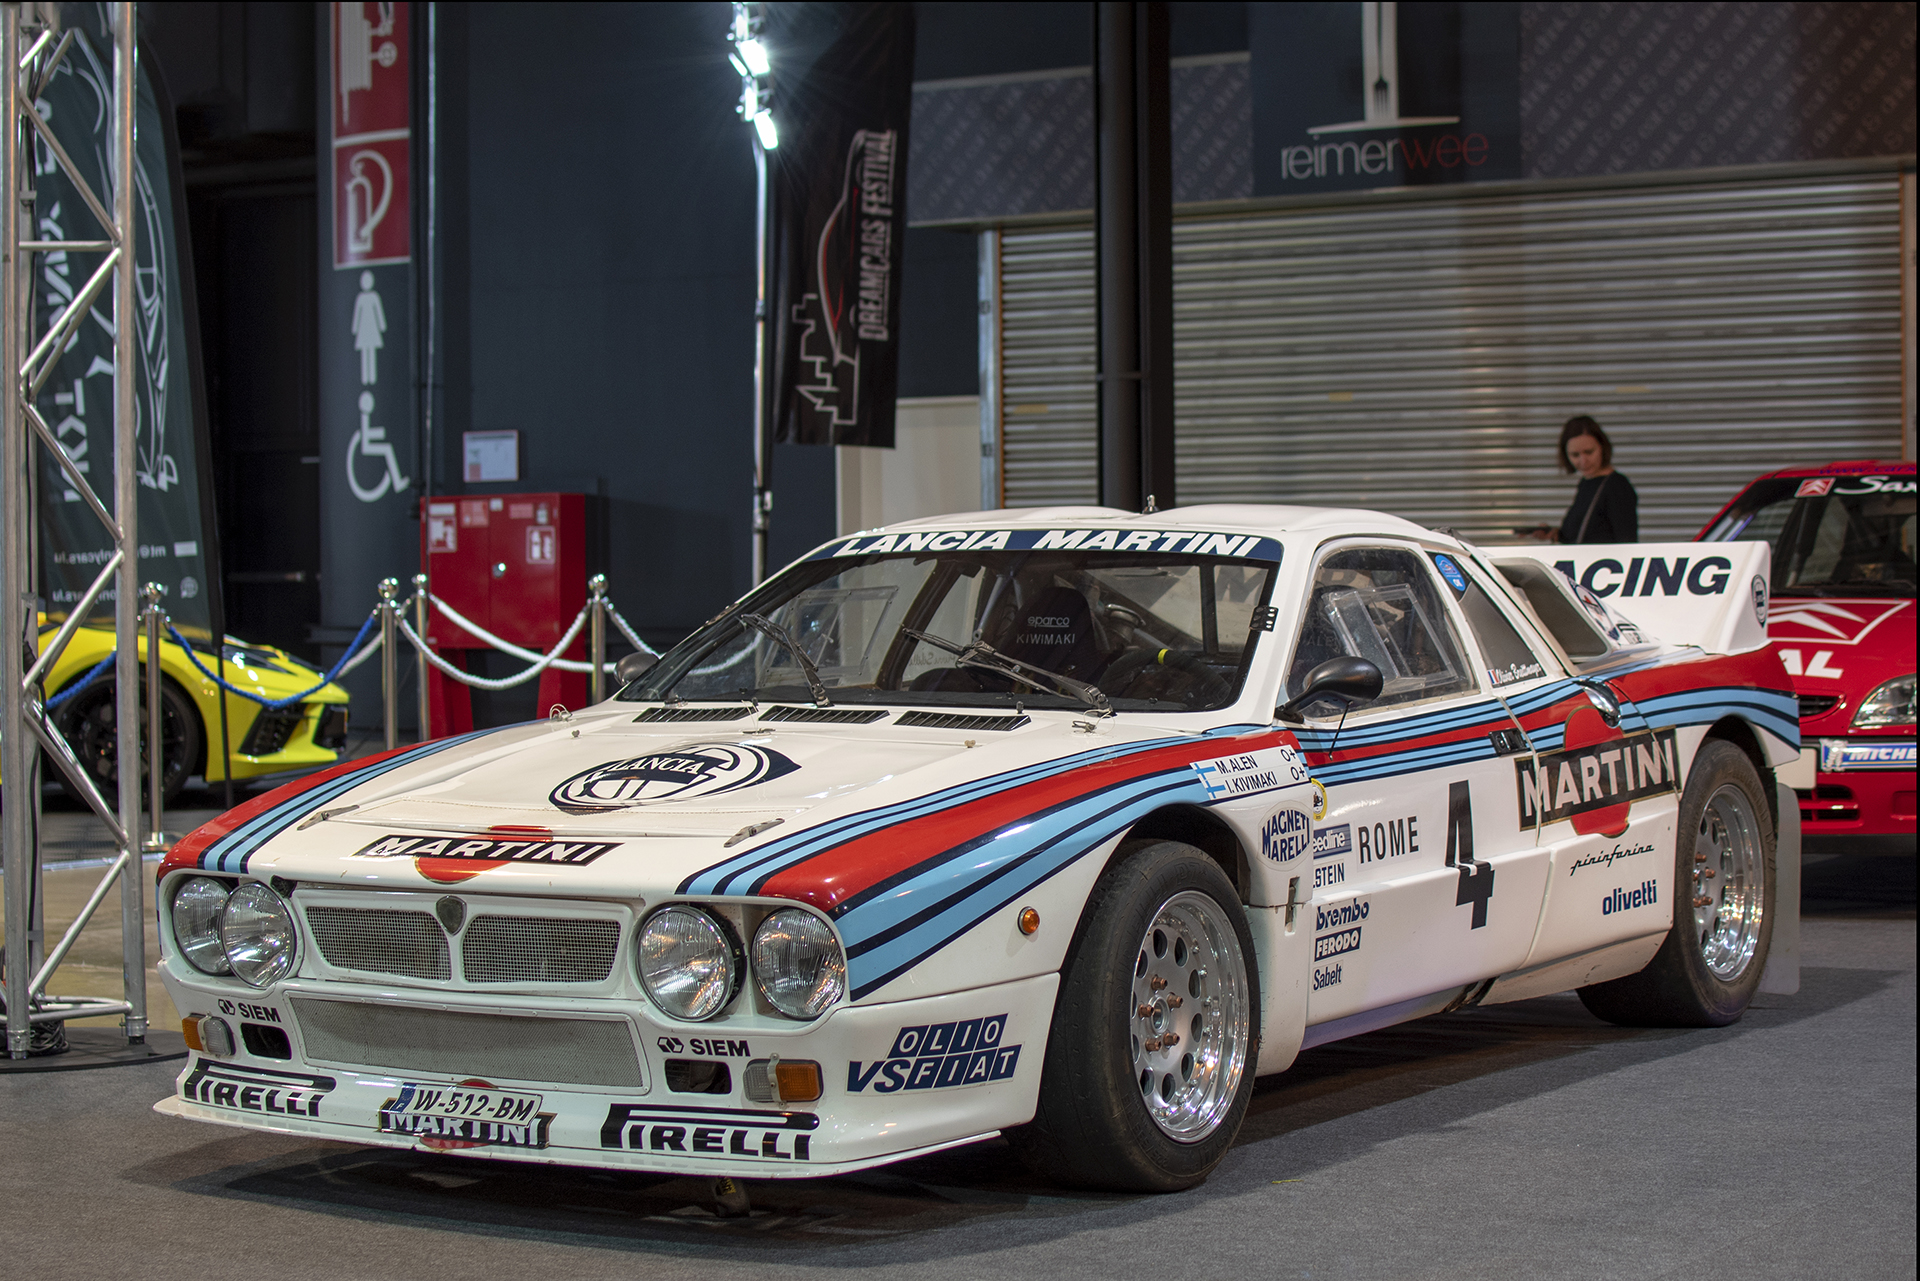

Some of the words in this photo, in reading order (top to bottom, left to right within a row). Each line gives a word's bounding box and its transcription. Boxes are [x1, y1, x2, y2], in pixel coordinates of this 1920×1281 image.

[862, 128, 897, 217] FESTIVAL
[859, 219, 891, 341] DREAMCARS
[832, 530, 1012, 557] LANCIA
[1032, 530, 1261, 557] MARTINI
[1027, 616, 1070, 627] sparco
[1016, 634, 1076, 645] KIWIMAKI
[1778, 649, 1844, 679] AL
[616, 757, 705, 775] LANCIA
[1521, 738, 1676, 817] MARTINI
[1262, 809, 1310, 838] MAGNETI
[374, 837, 606, 863] MARTINI
[1262, 832, 1310, 862] MARELLI
[1358, 816, 1419, 864] ROME
[1445, 779, 1495, 930] 4
[1569, 843, 1655, 876] pininfarina
[1313, 862, 1345, 889] STEIN
[1602, 879, 1657, 915] olivetti
[1316, 898, 1370, 931] brembo
[1316, 930, 1360, 958] FERODO
[1313, 963, 1342, 991] Sabelt
[238, 1002, 281, 1023] SIEM
[690, 1038, 751, 1057] SIEM
[894, 1016, 1004, 1056] OLIO
[184, 1057, 337, 1117] PIRELLI
[413, 1089, 536, 1122] W-512-BM
[389, 1112, 542, 1145] MARTINI
[600, 1103, 820, 1160] PIRELLI
